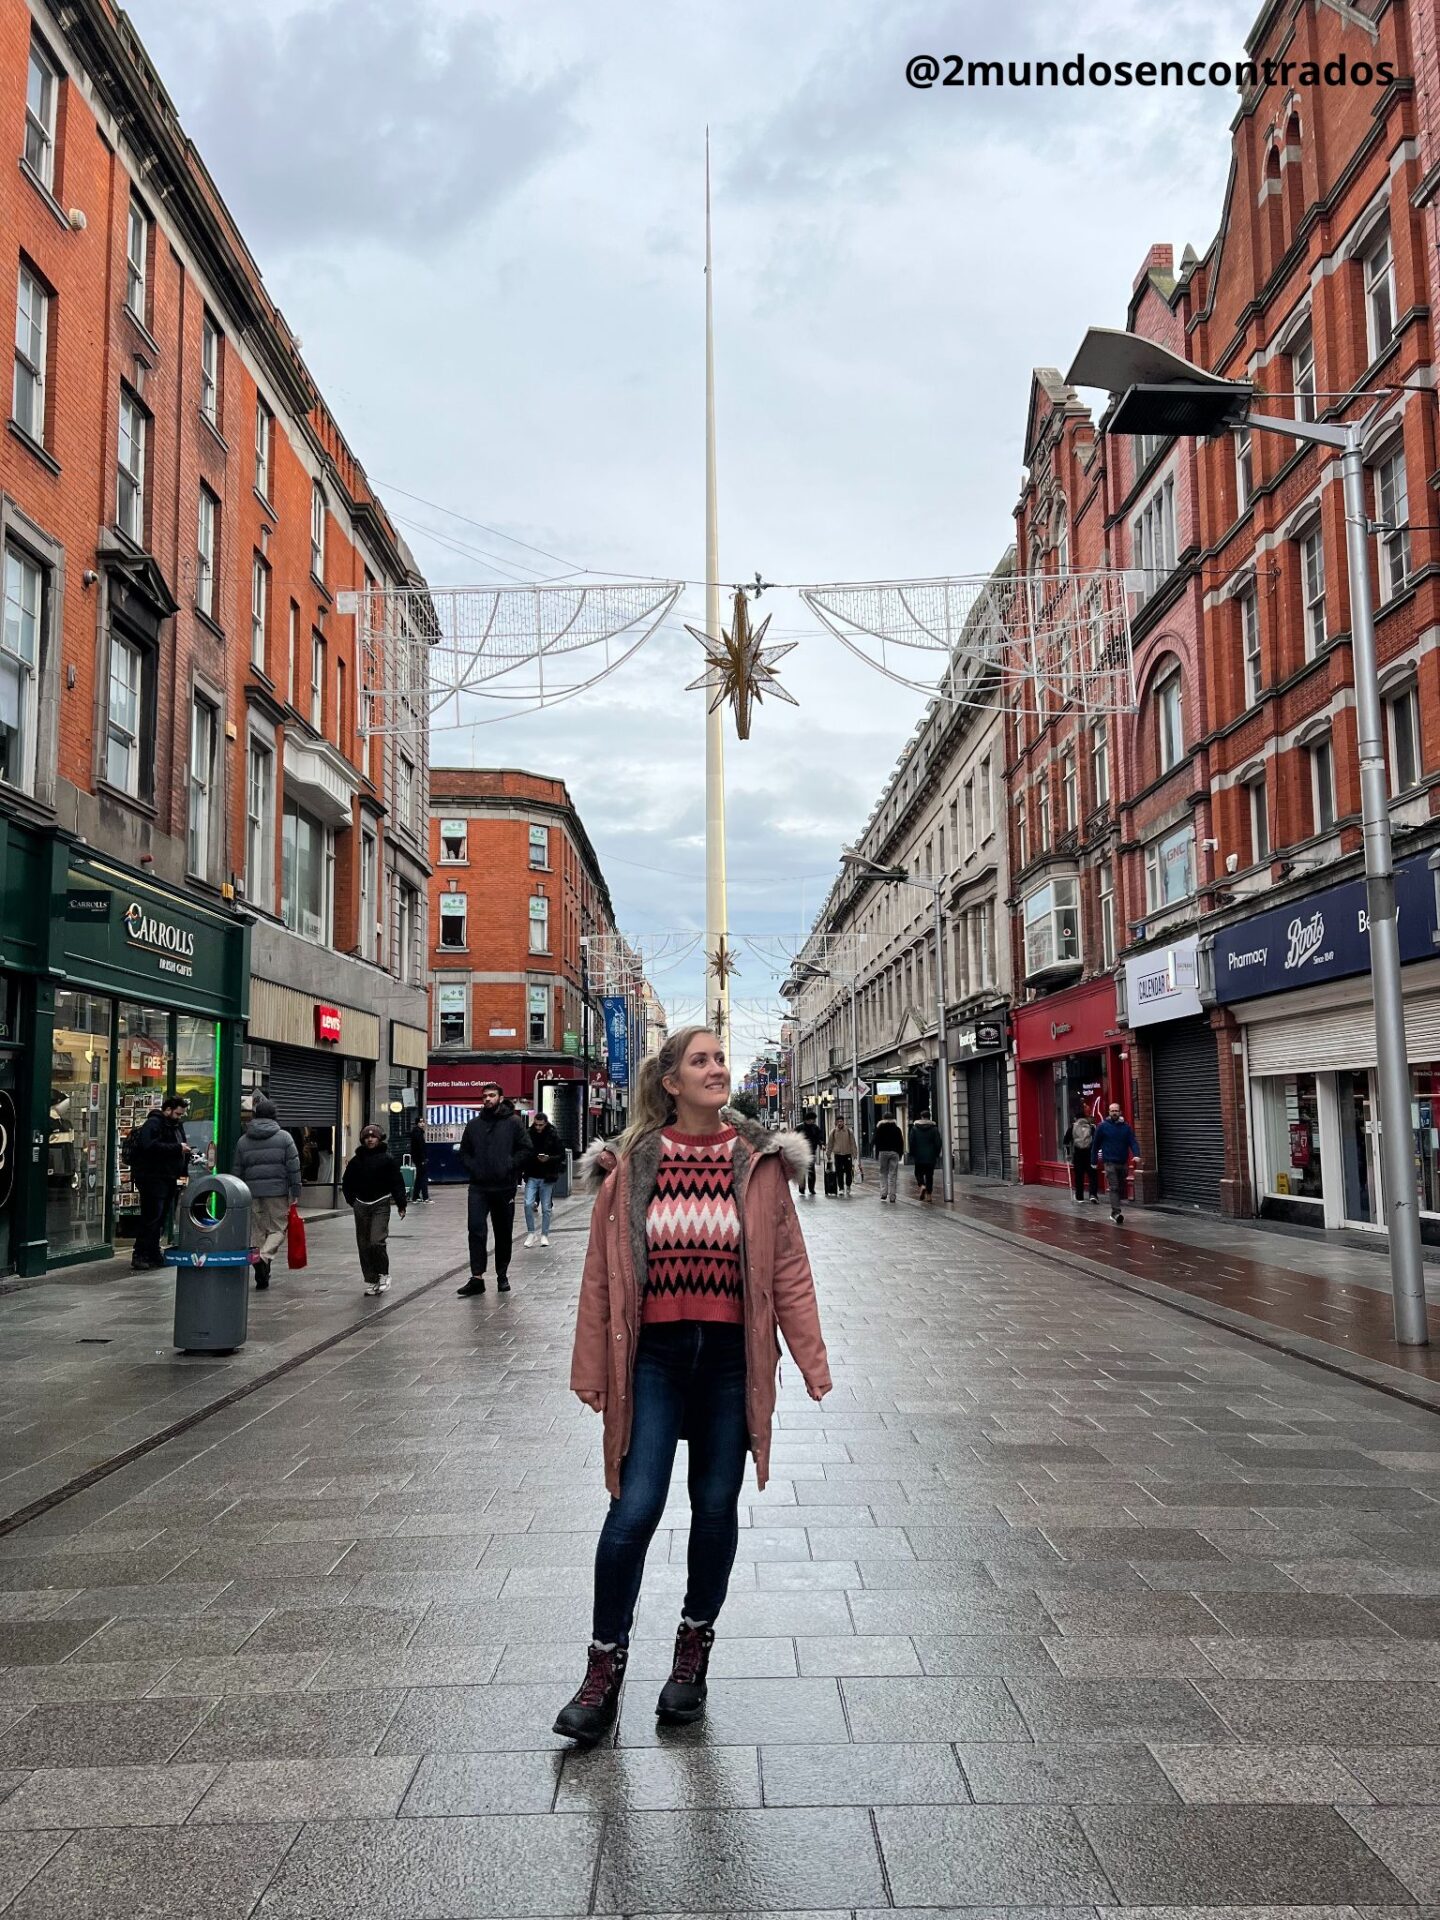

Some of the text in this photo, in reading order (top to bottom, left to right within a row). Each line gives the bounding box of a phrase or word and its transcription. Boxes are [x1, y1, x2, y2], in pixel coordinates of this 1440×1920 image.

[1166, 842, 1186, 861] GNC
[69, 900, 108, 908] CARROLLS
[126, 902, 194, 956] CARROLLS
[1284, 911, 1325, 969] Boots
[159, 958, 193, 977] IRISH GIFTS
[1228, 947, 1268, 971] Pharmacy
[1312, 955, 1325, 965] Since
[1138, 974, 1165, 1000] CALENDAR
